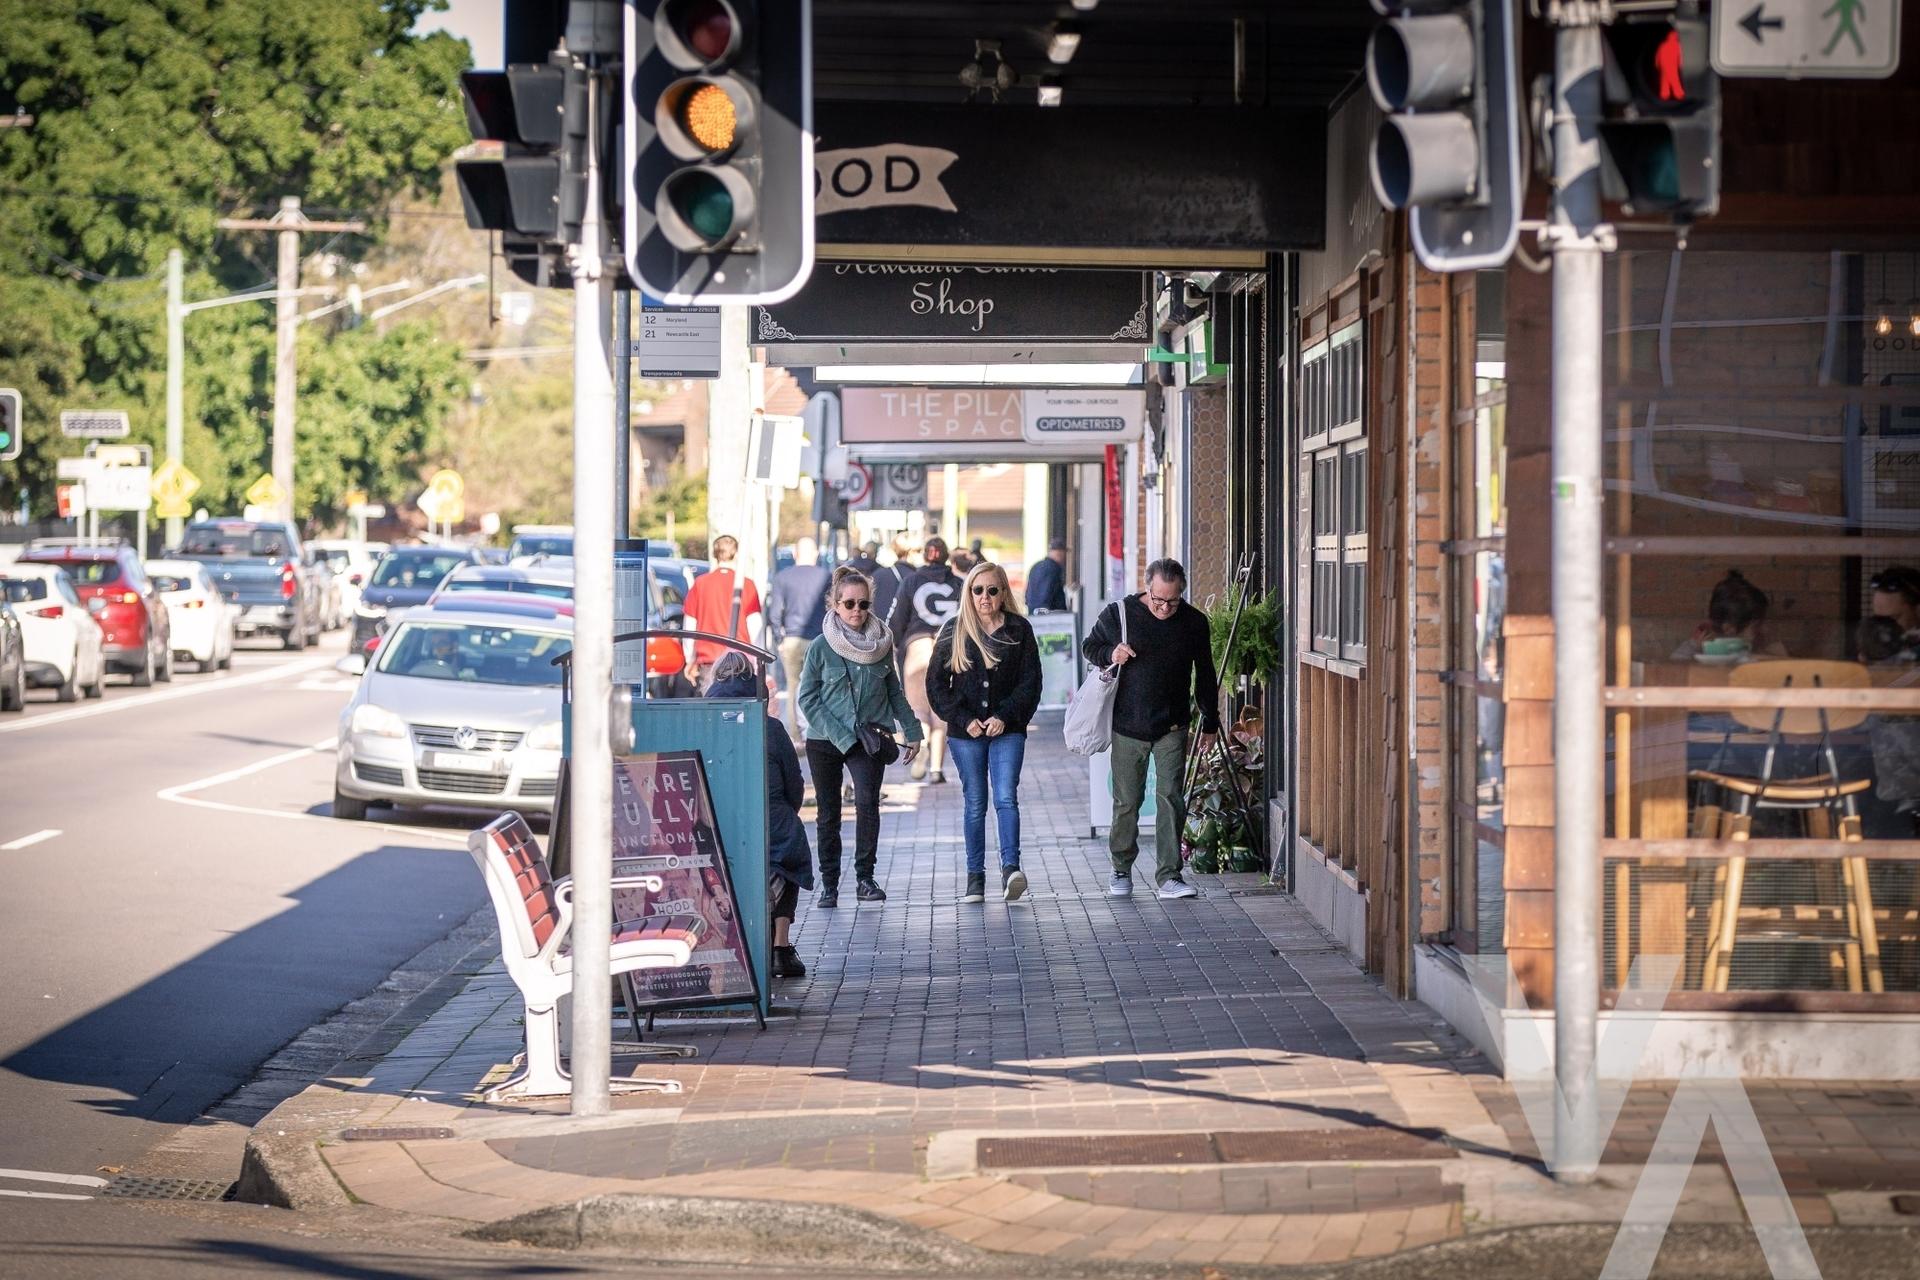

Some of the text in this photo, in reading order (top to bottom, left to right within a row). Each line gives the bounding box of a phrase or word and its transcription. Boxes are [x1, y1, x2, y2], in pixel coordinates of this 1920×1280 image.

[815, 155, 921, 198] OD
[910, 277, 995, 332] Shop
[644, 315, 657, 325] 12
[644, 329, 657, 339] 21
[880, 392, 943, 417] THE
[1039, 418, 1122, 430] OPTOMETRISTS
[913, 581, 962, 627] G
[645, 771, 693, 794] ARE
[657, 901, 691, 916] HOOD
[676, 980, 703, 989] EVENTS
